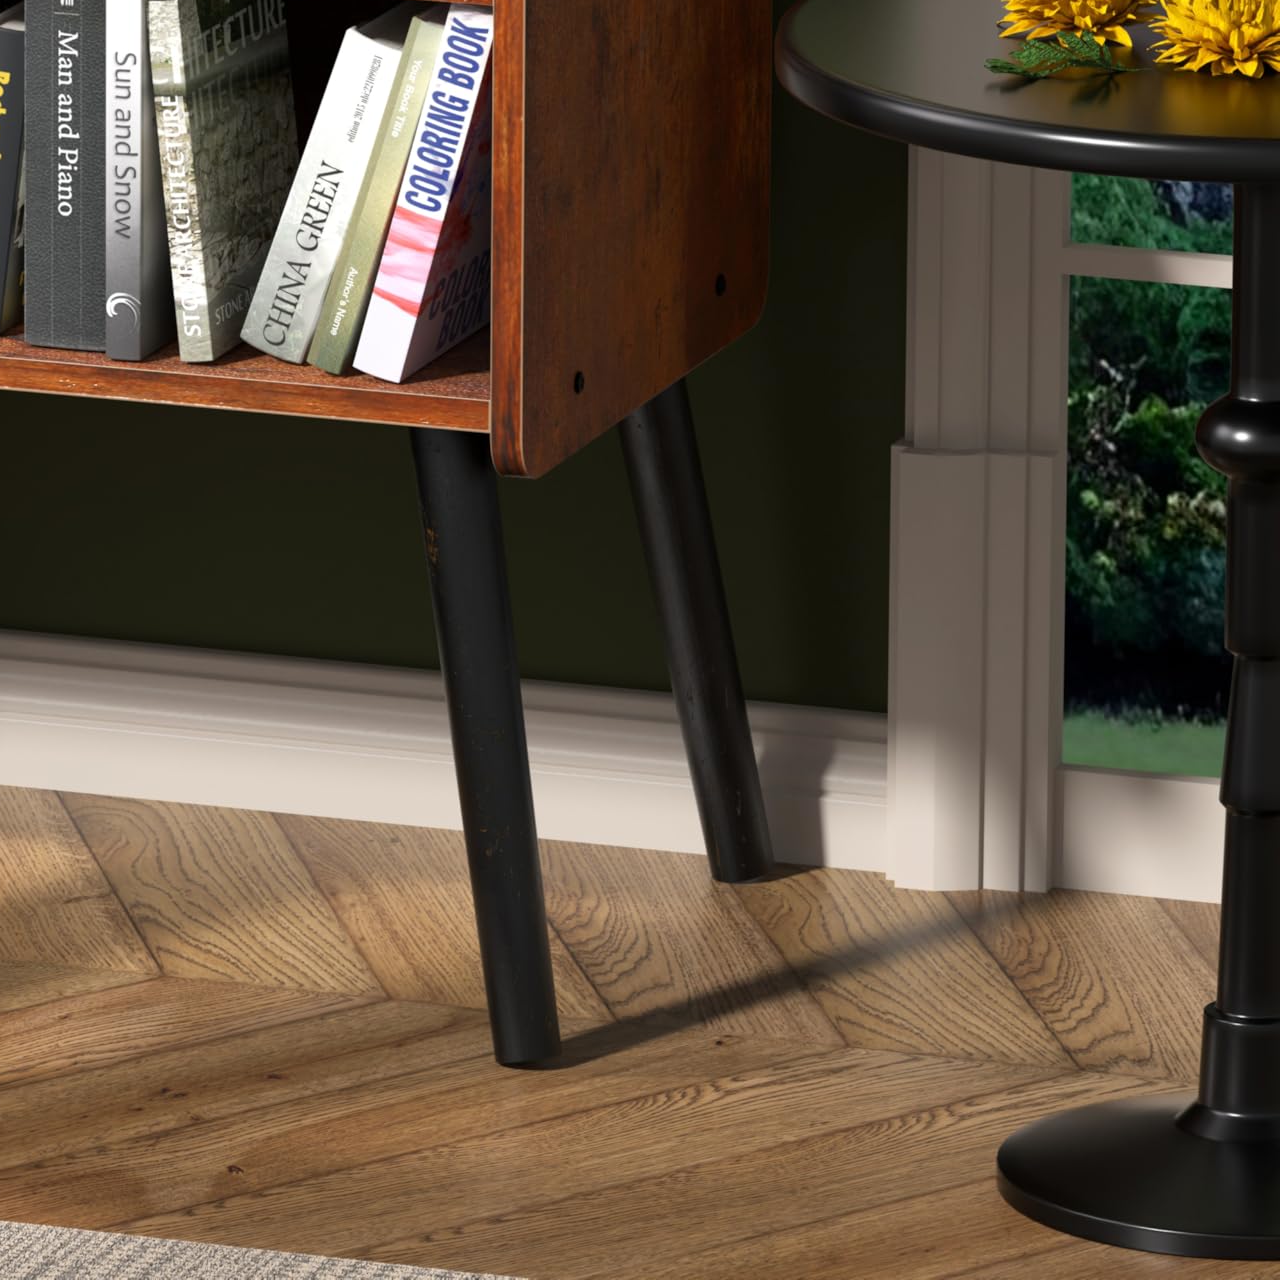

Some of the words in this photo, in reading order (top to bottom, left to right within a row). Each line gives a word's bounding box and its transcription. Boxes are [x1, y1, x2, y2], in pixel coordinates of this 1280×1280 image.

[57, 29, 79, 87] Man
[114, 51, 137, 101] Sun
[409, 60, 423, 83] Your
[57, 91, 80, 141] and
[399, 84, 415, 113] Book
[405, 91, 470, 214] COLORING
[438, 17, 489, 92] BOOK
[114, 107, 139, 157] and
[391, 116, 406, 138] Title
[57, 145, 80, 218] Piano
[160, 95, 193, 256] ARCHITECTURE
[113, 163, 137, 240] Snow
[262, 260, 312, 347] CHINA
[296, 160, 345, 252] GREEN
[215, 293, 244, 326] STONE
[340, 267, 358, 306] Author's
[330, 308, 346, 336] Name
